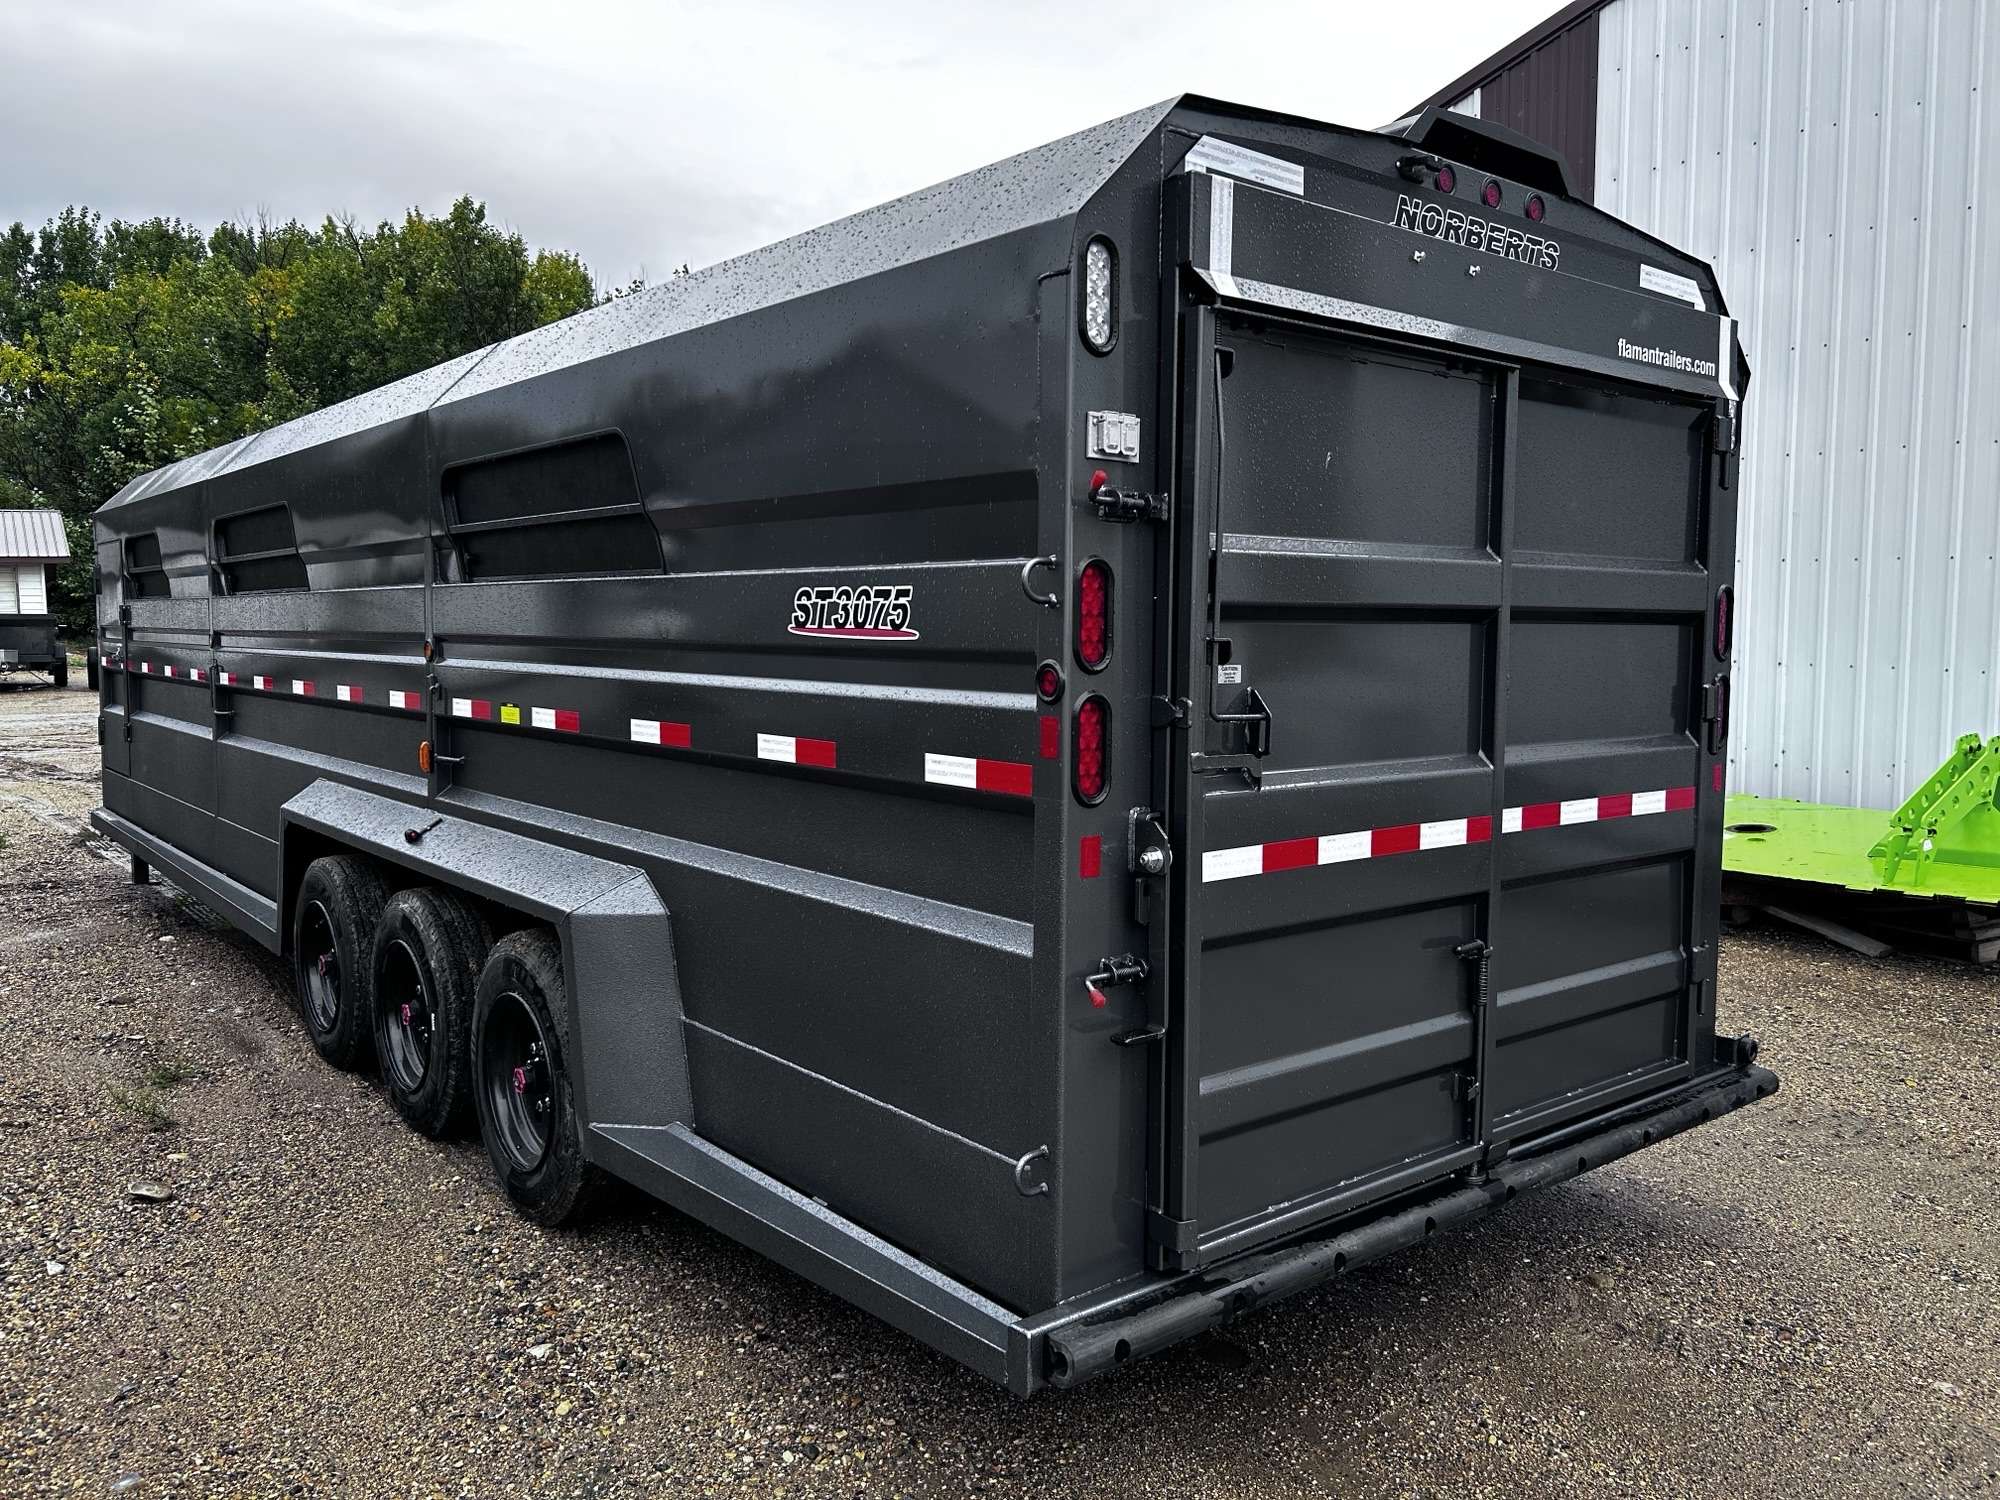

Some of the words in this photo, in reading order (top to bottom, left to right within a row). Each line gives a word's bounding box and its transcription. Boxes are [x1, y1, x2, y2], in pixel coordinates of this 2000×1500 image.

[1391, 194, 1560, 271] NORBERTS
[1618, 338, 1716, 377] flamantrailers.com
[792, 586, 913, 631] ST3075
